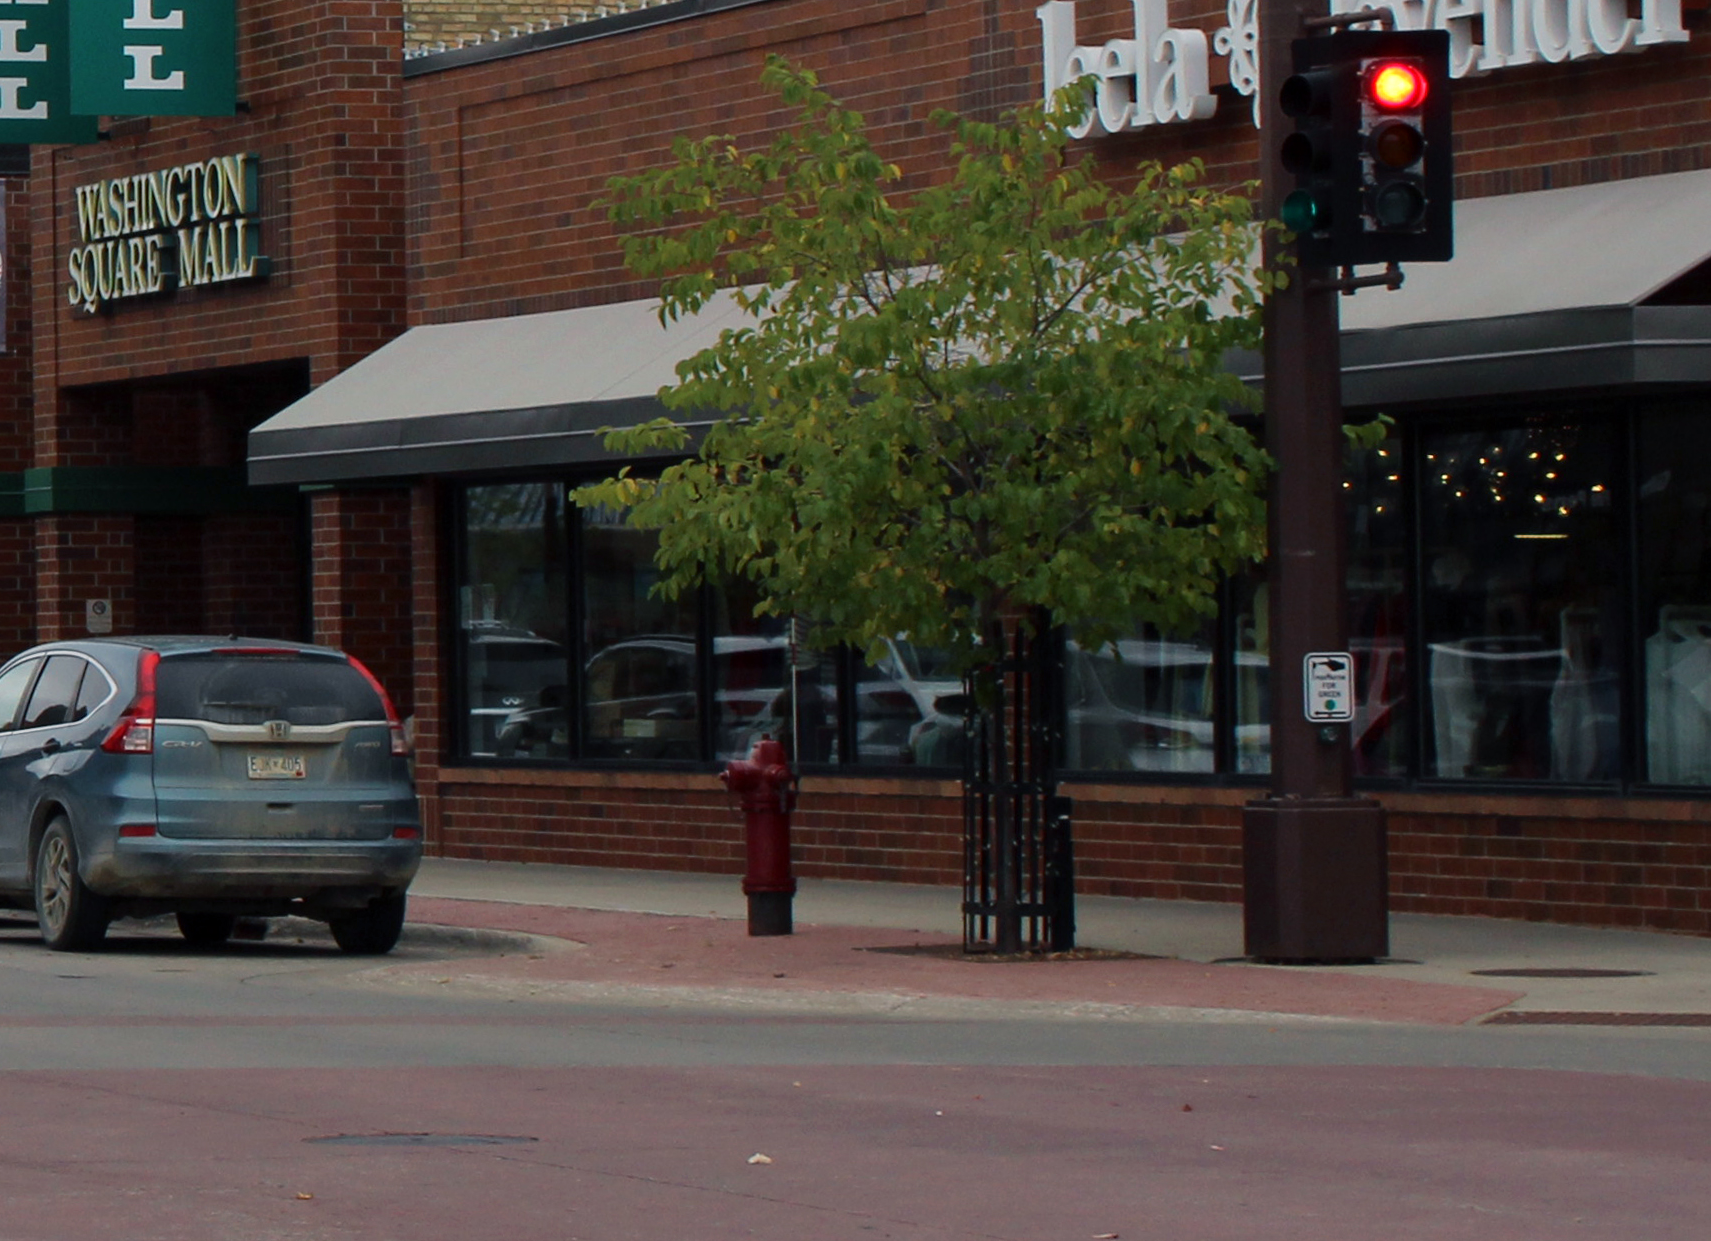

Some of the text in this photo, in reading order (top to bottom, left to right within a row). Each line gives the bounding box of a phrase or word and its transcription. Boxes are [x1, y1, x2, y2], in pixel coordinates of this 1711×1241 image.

[76, 153, 252, 243] WASHINGTON
[68, 218, 261, 314] SQUARE MALL
[161, 740, 203, 749] CR-V
[281, 756, 303, 772] 405
